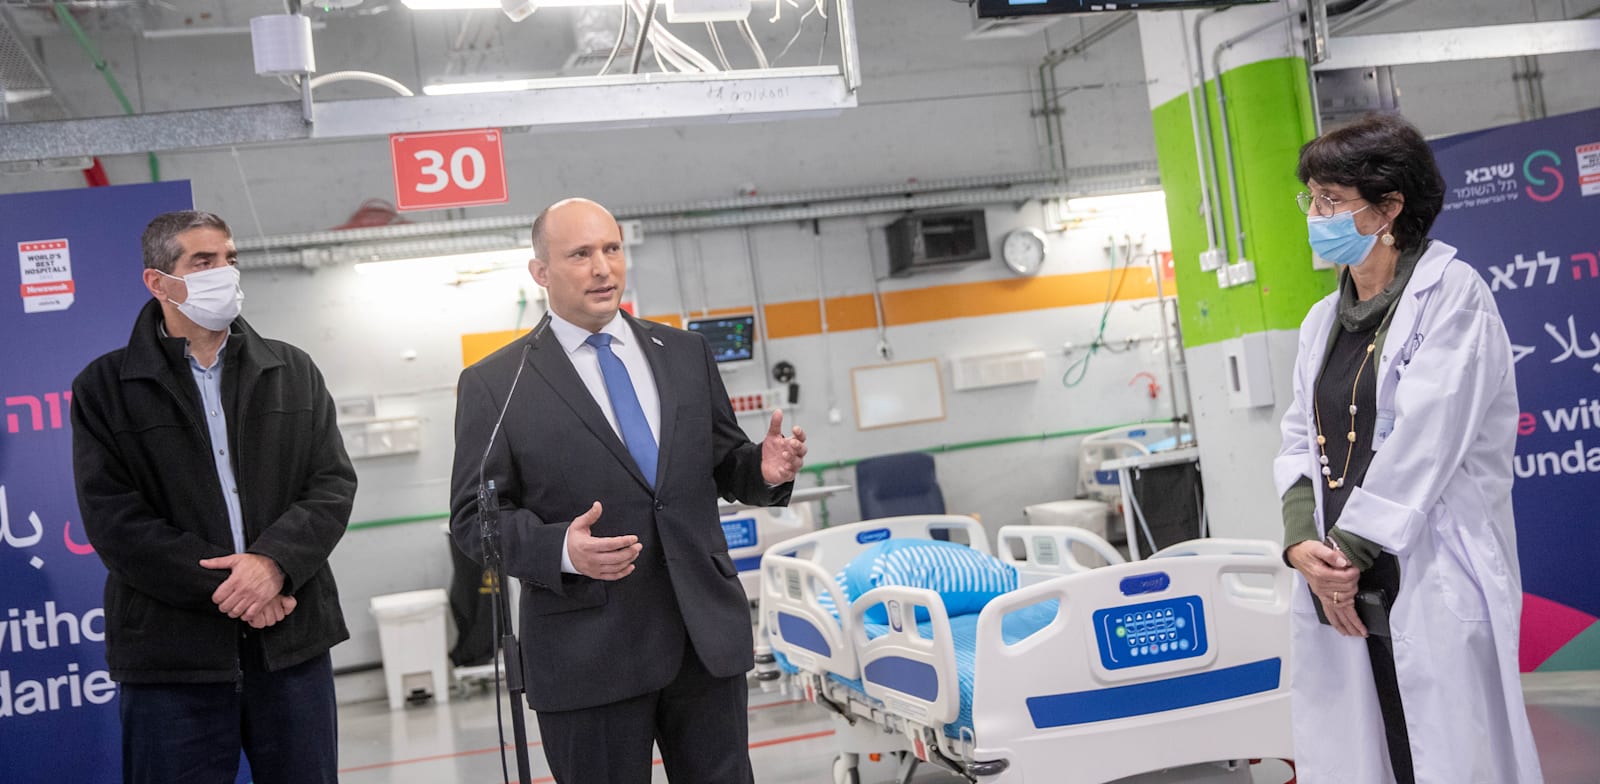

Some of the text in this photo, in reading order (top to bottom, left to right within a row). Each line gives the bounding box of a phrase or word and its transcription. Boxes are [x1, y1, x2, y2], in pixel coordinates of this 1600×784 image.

[413, 146, 486, 193] 30
[1465, 162, 1514, 184] שיבא
[1452, 179, 1517, 199] תל השומר
[25, 266, 67, 275] HOSPITALS
[1488, 250, 1600, 292] ה ללא
[0, 601, 105, 652] itho
